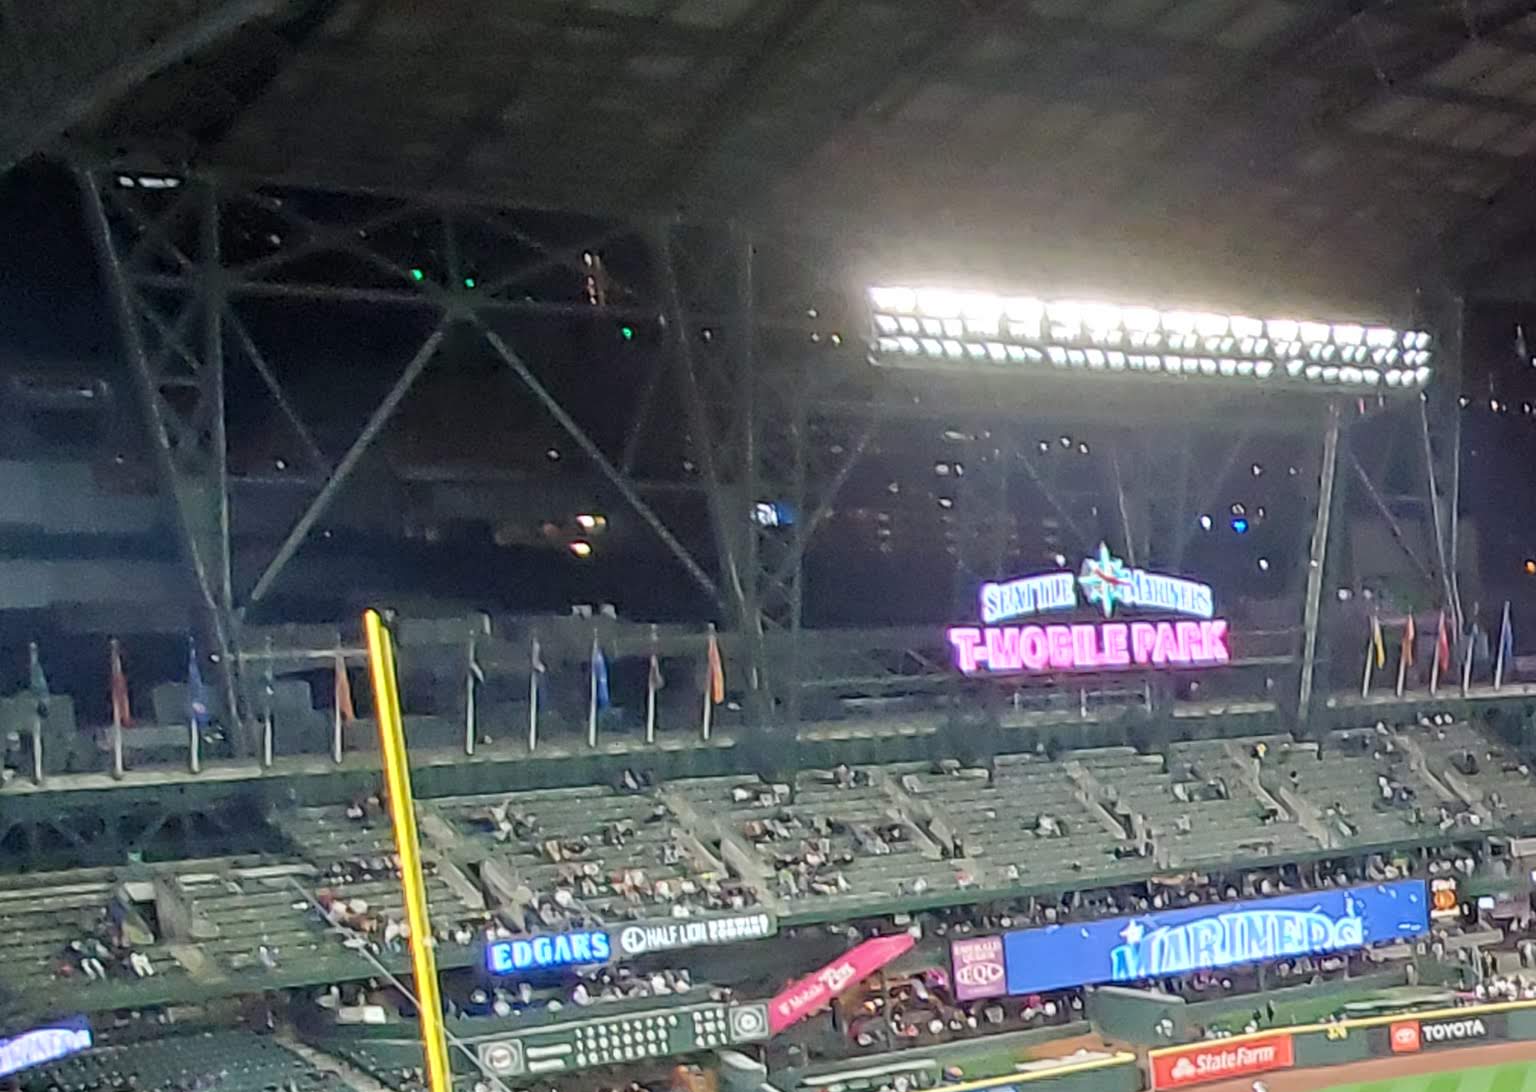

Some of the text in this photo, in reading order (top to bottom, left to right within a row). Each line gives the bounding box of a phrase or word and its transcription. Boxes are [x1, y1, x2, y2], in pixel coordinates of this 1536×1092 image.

[981, 569, 1214, 623] SEATTLE MARINERS
[949, 619, 1230, 675] T-MOBILE PARK
[646, 925, 679, 948] HALF
[1422, 1019, 1486, 1042] TOYOTA
